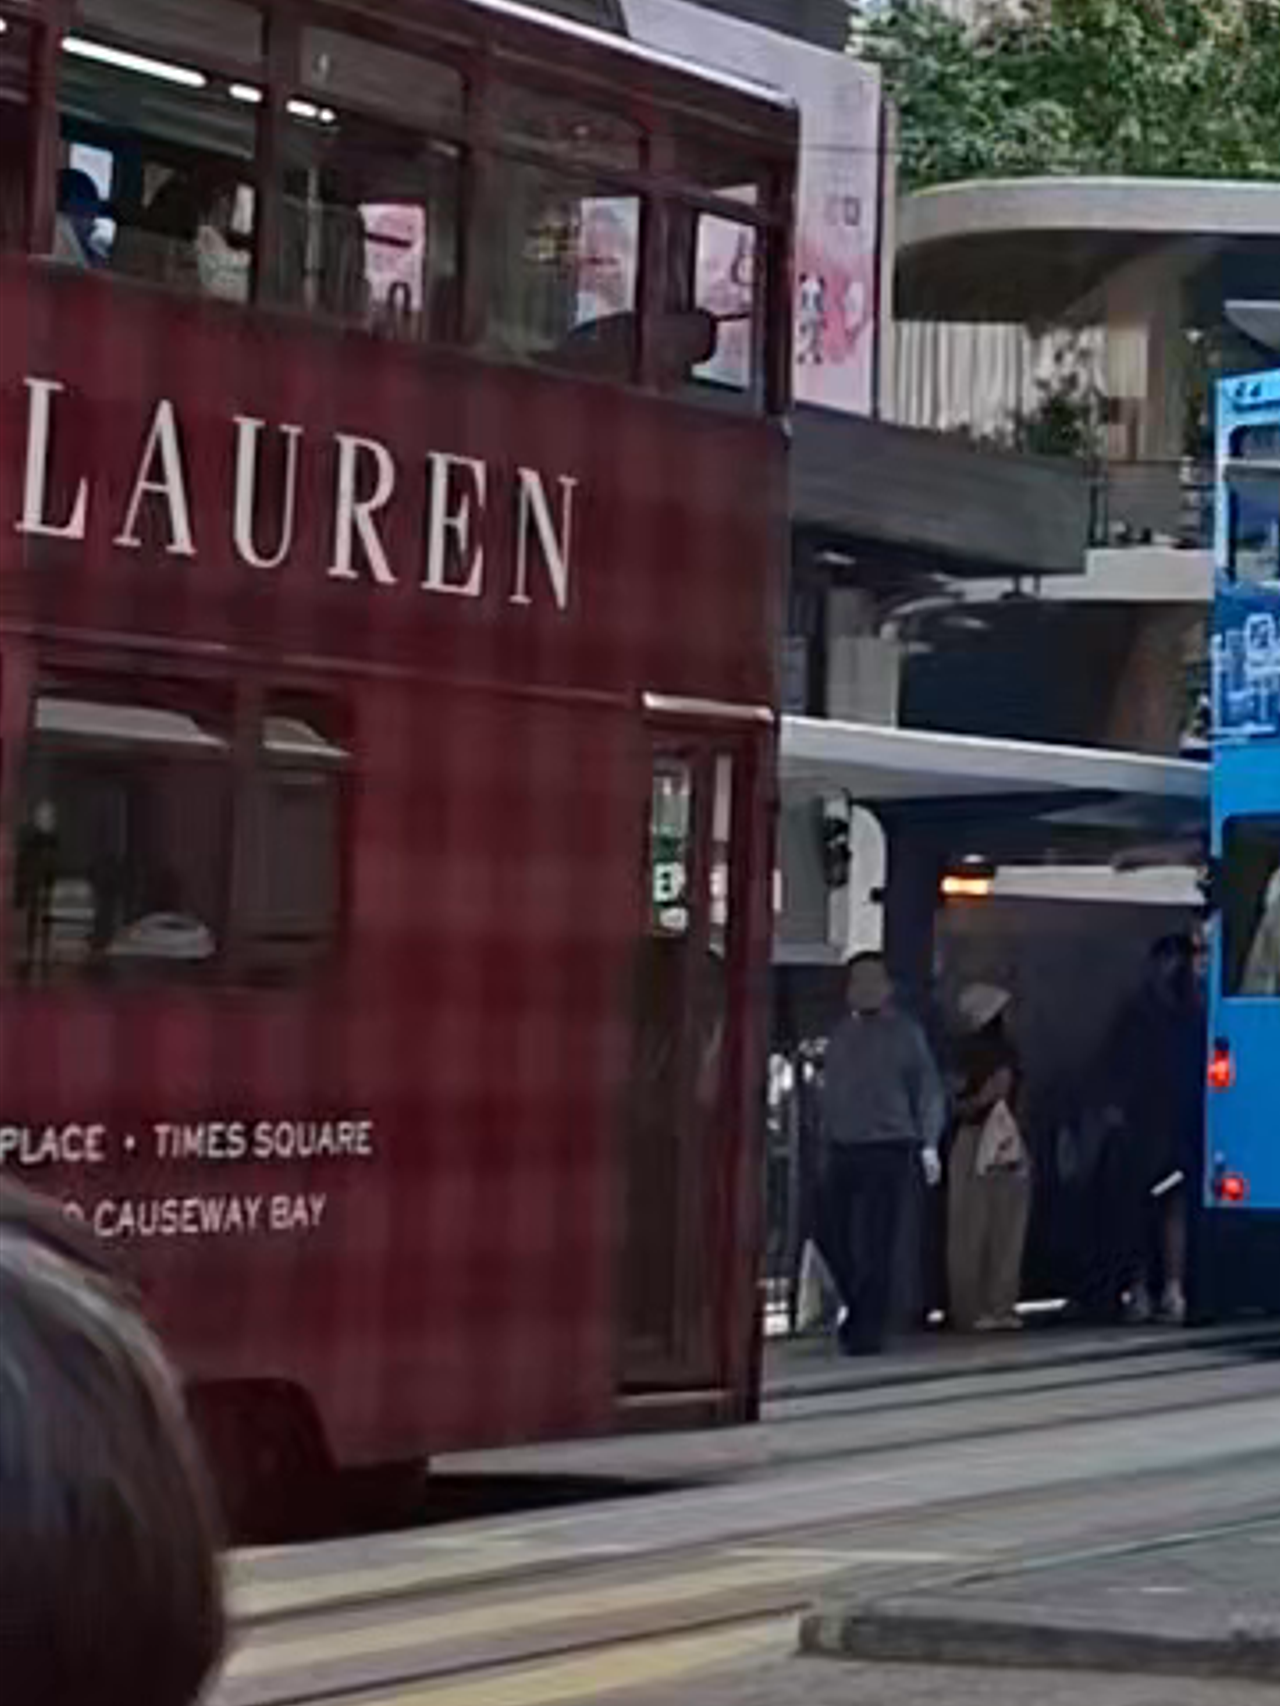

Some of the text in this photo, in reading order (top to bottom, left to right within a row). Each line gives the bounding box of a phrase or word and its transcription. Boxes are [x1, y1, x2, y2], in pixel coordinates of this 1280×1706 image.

[14, 376, 579, 611] LAUREN
[0, 1120, 375, 1164] PLACE TIMES SQUARE
[93, 1195, 264, 1238] CAUSEWAY
[268, 1193, 328, 1231] BAY
